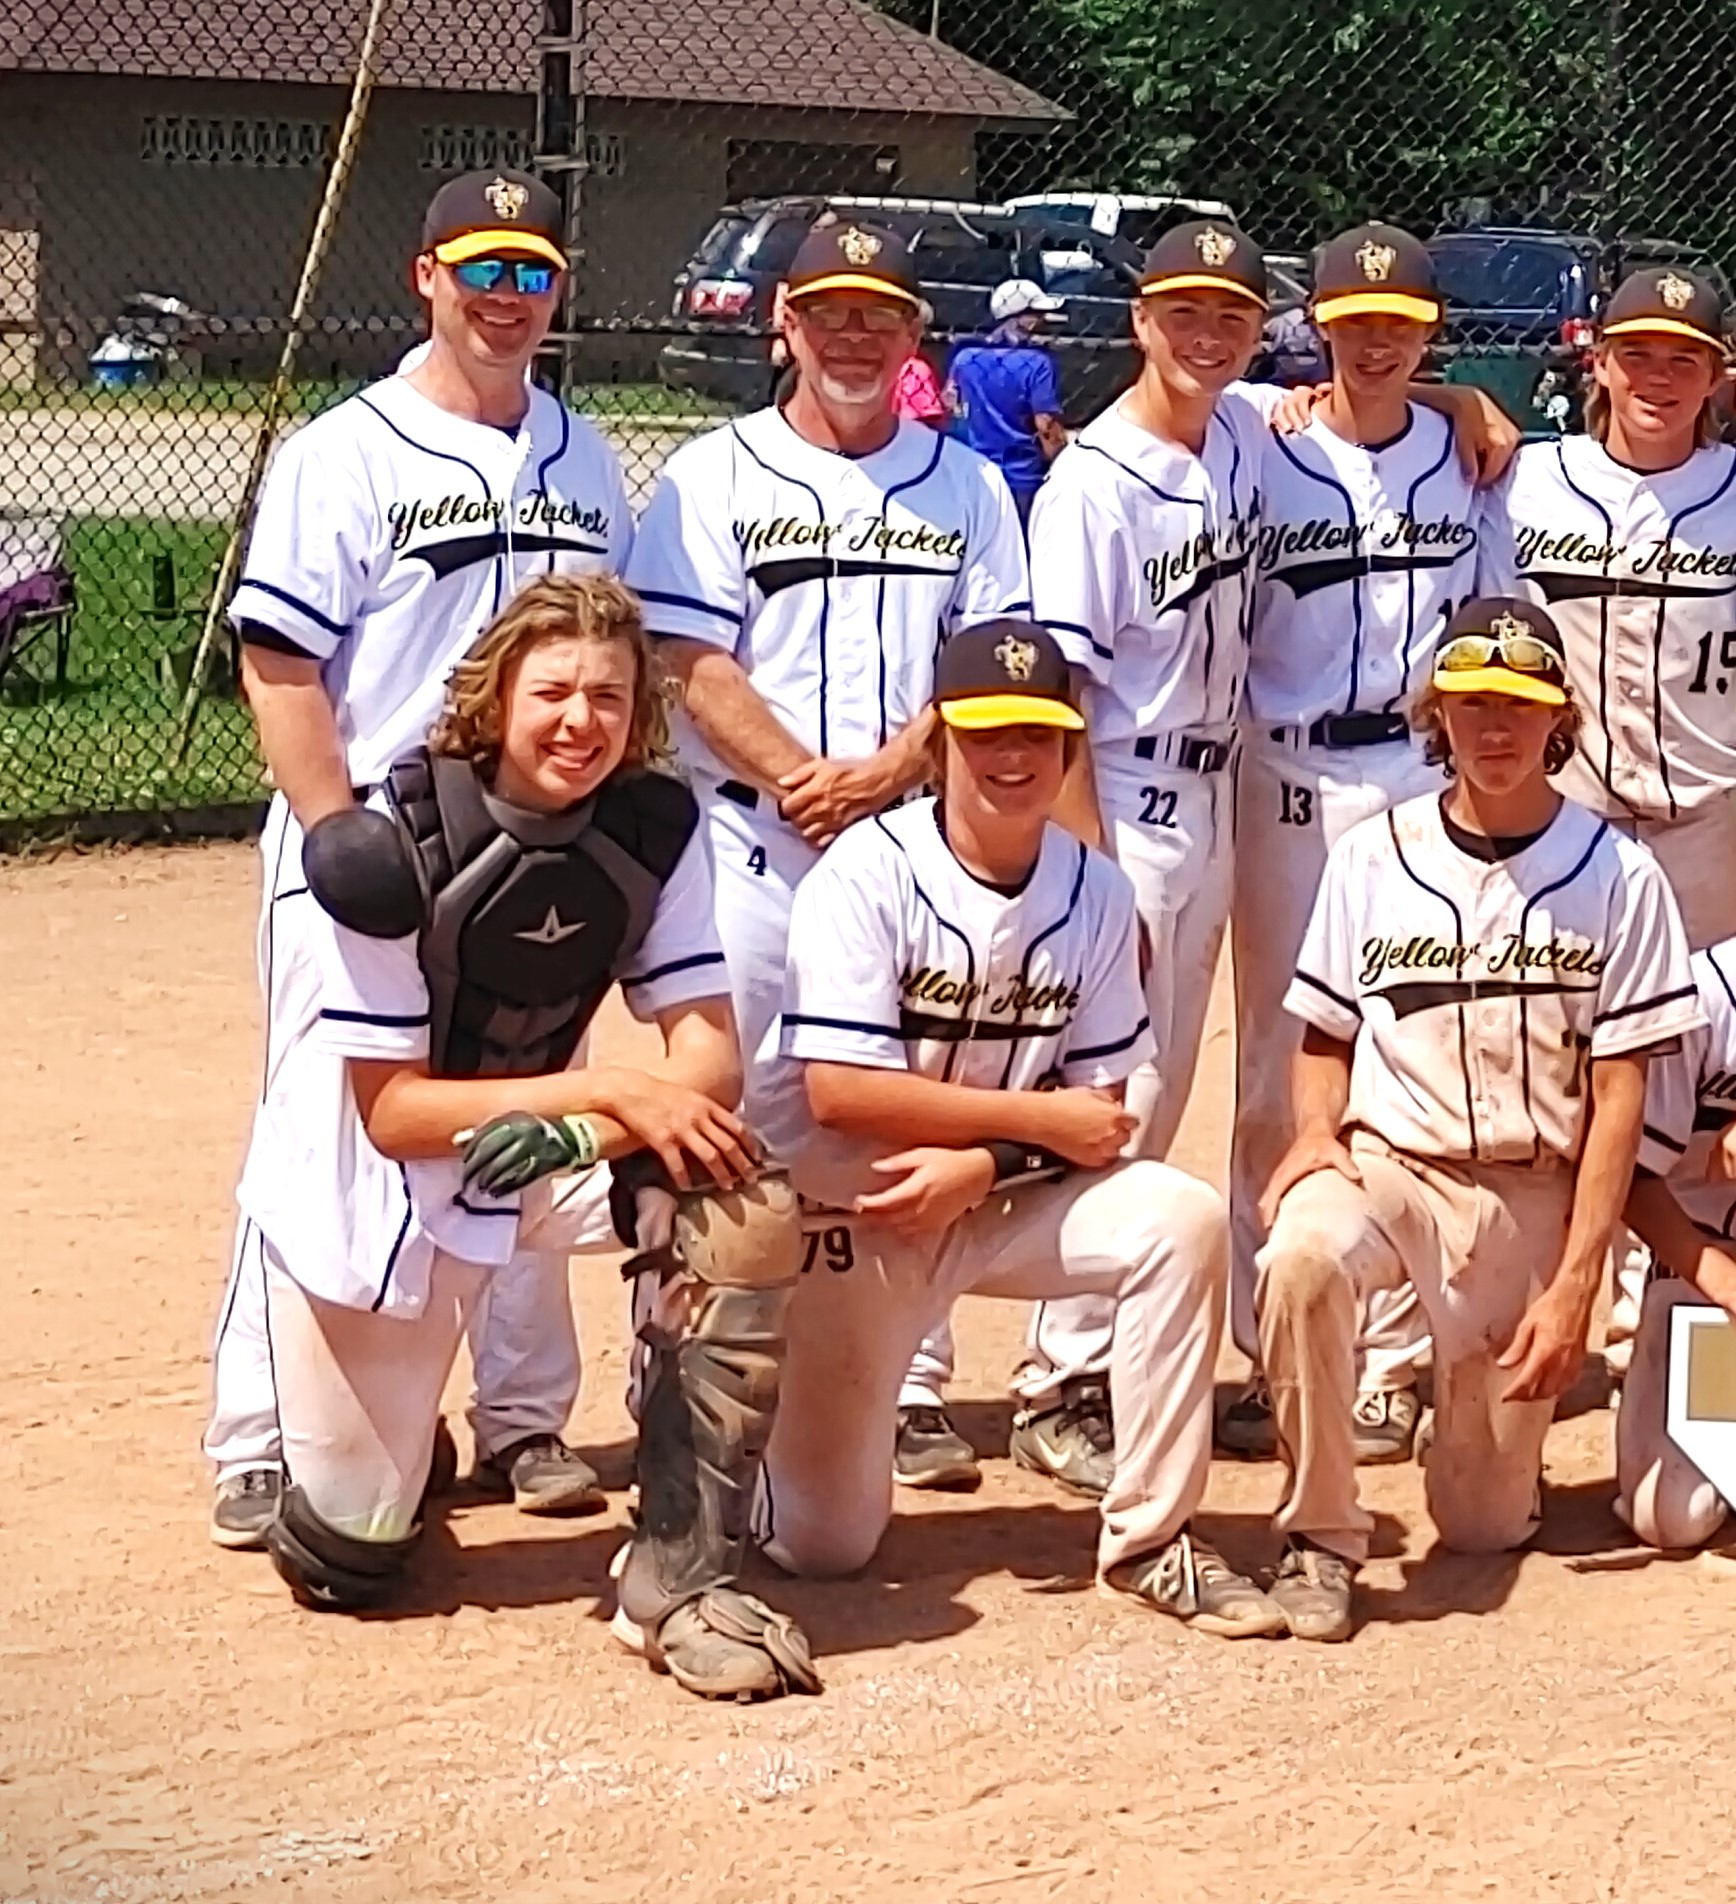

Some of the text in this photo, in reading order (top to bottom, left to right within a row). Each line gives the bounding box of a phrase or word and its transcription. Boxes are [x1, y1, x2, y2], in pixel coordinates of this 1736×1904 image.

[388, 494, 503, 550] Yellow
[1257, 518, 1372, 570] Yellow
[1515, 526, 1627, 568] Yellow
[1137, 786, 1178, 829] 22
[1278, 780, 1313, 826] 13
[746, 845, 767, 876] 4
[1359, 937, 1480, 986] Yellow
[801, 1226, 854, 1272] 79
